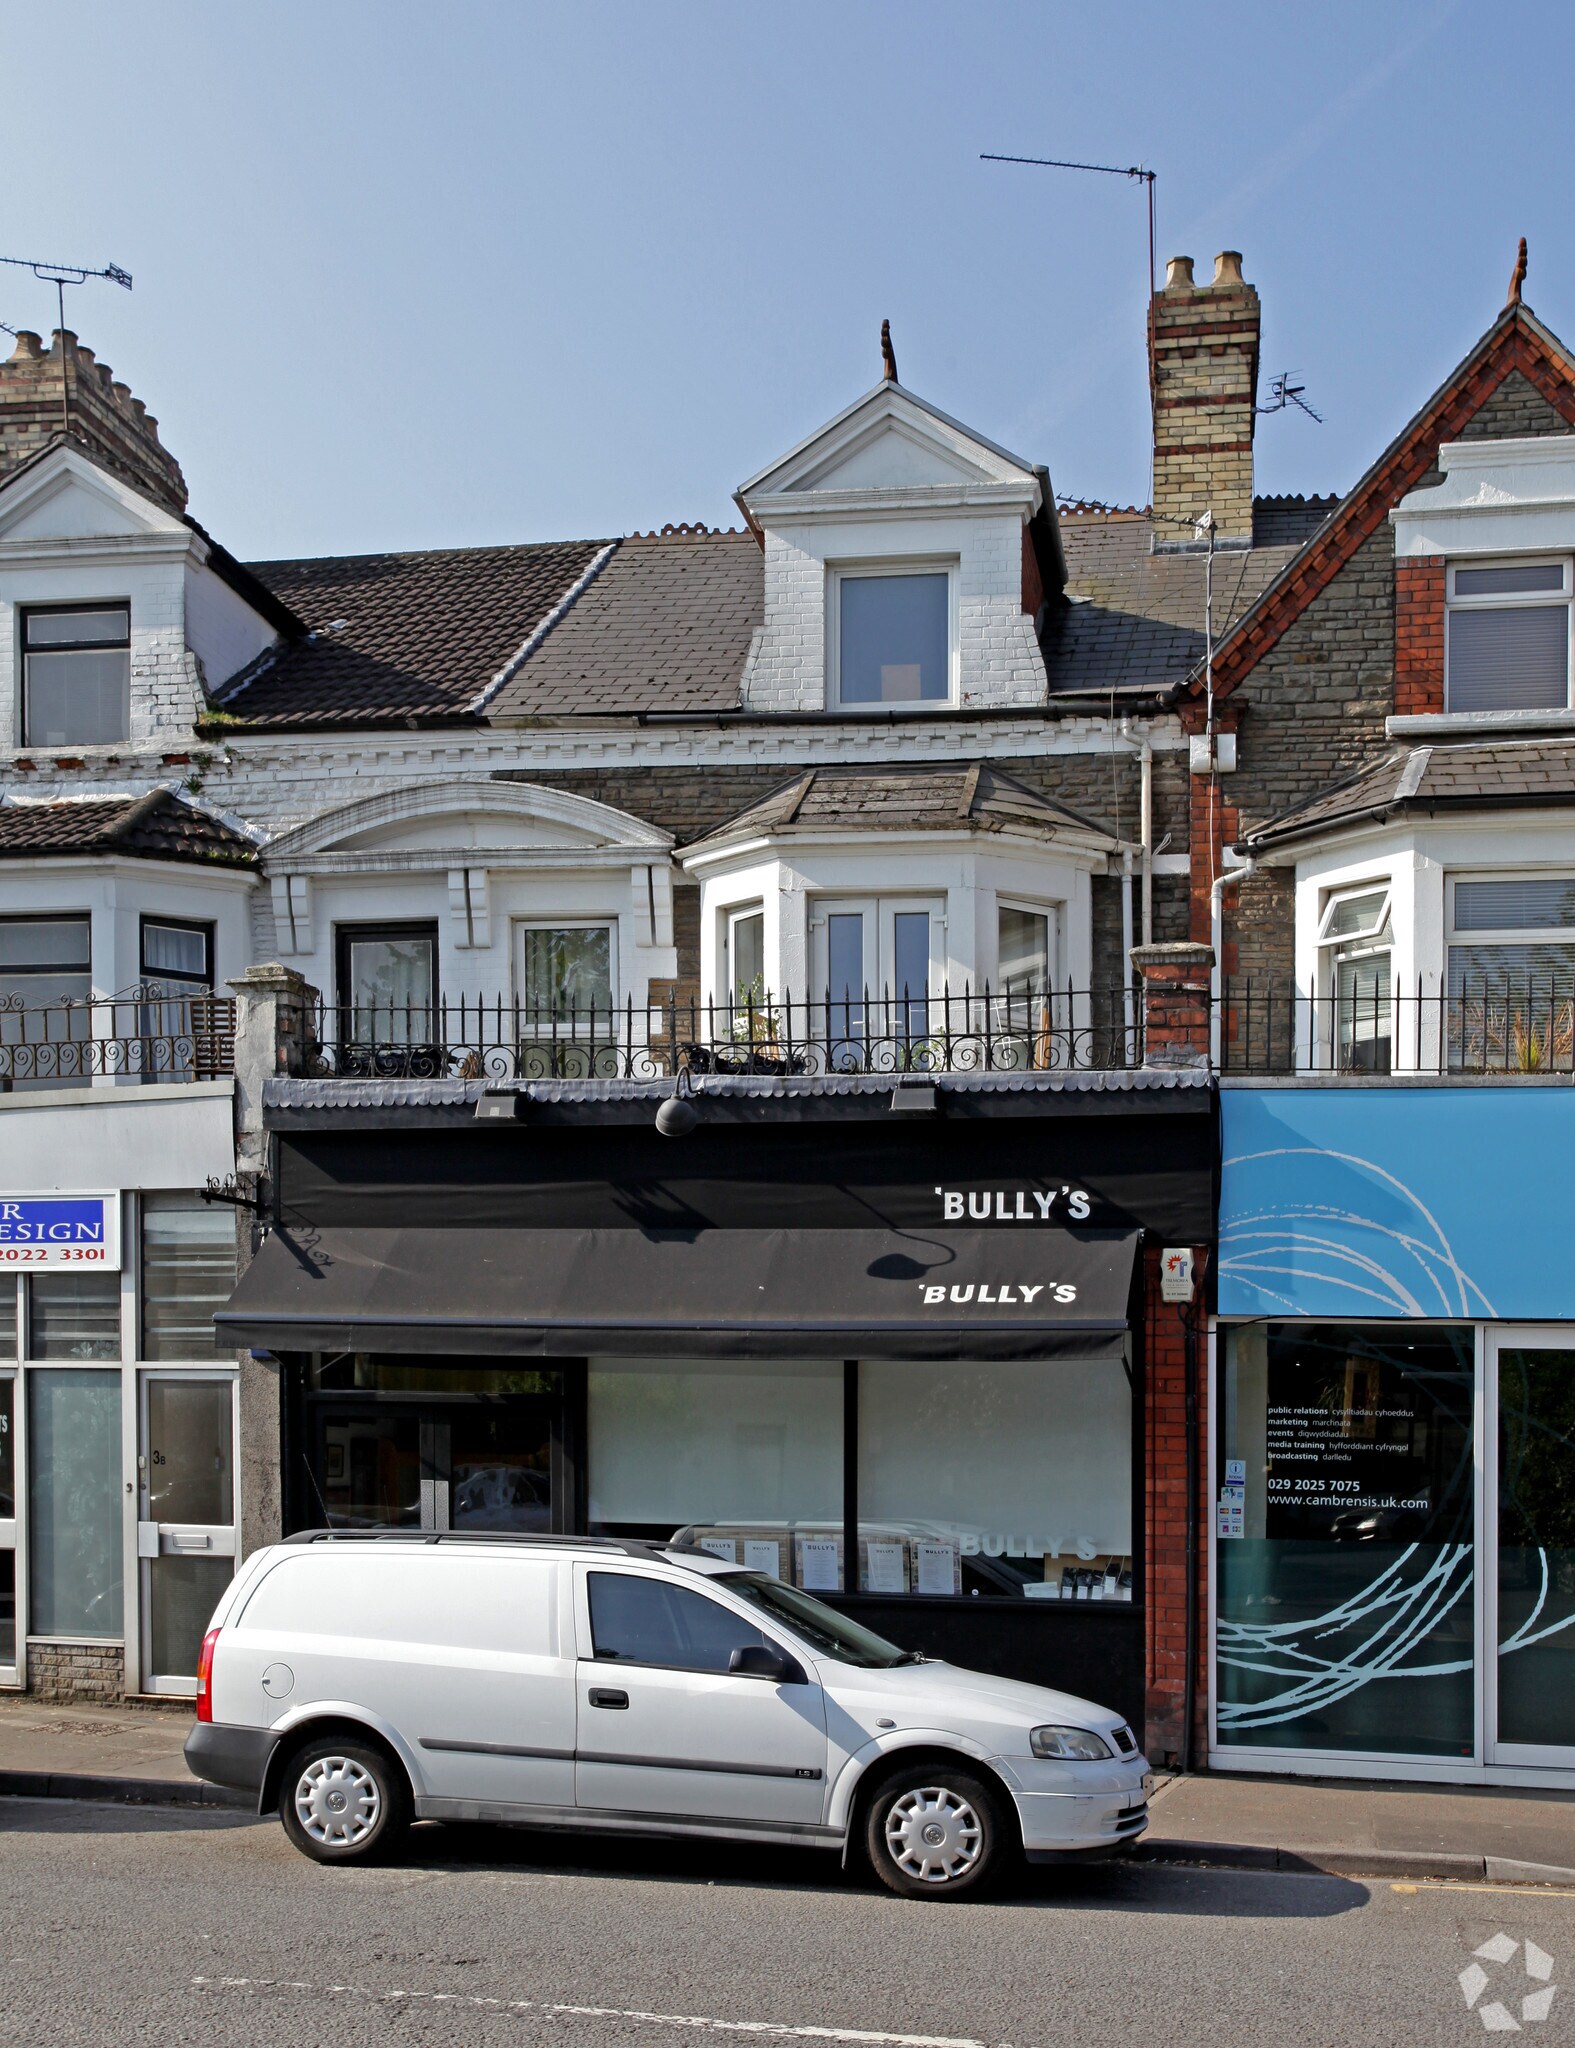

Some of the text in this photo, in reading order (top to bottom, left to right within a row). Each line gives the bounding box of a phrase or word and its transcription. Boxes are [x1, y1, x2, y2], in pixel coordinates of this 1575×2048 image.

[60, 1248, 105, 1260] 3301
[1268, 1407, 1292, 1415] public
[1294, 1407, 1328, 1415] relations
[1375, 1409, 1414, 1417] cyhoeddus
[1268, 1418, 1351, 1427] marketing marchnata
[1298, 1430, 1349, 1439] digwyddiadau
[1294, 1441, 1325, 1450] training
[1329, 1442, 1374, 1451] hyfforddiant
[1375, 1443, 1409, 1452] cyfryngol
[1268, 1451, 1352, 1461] broadcasting darlledu
[1268, 1479, 1360, 1492] 029 2025 7075
[1268, 1495, 1428, 1509] www.cambrensis.uk.com
